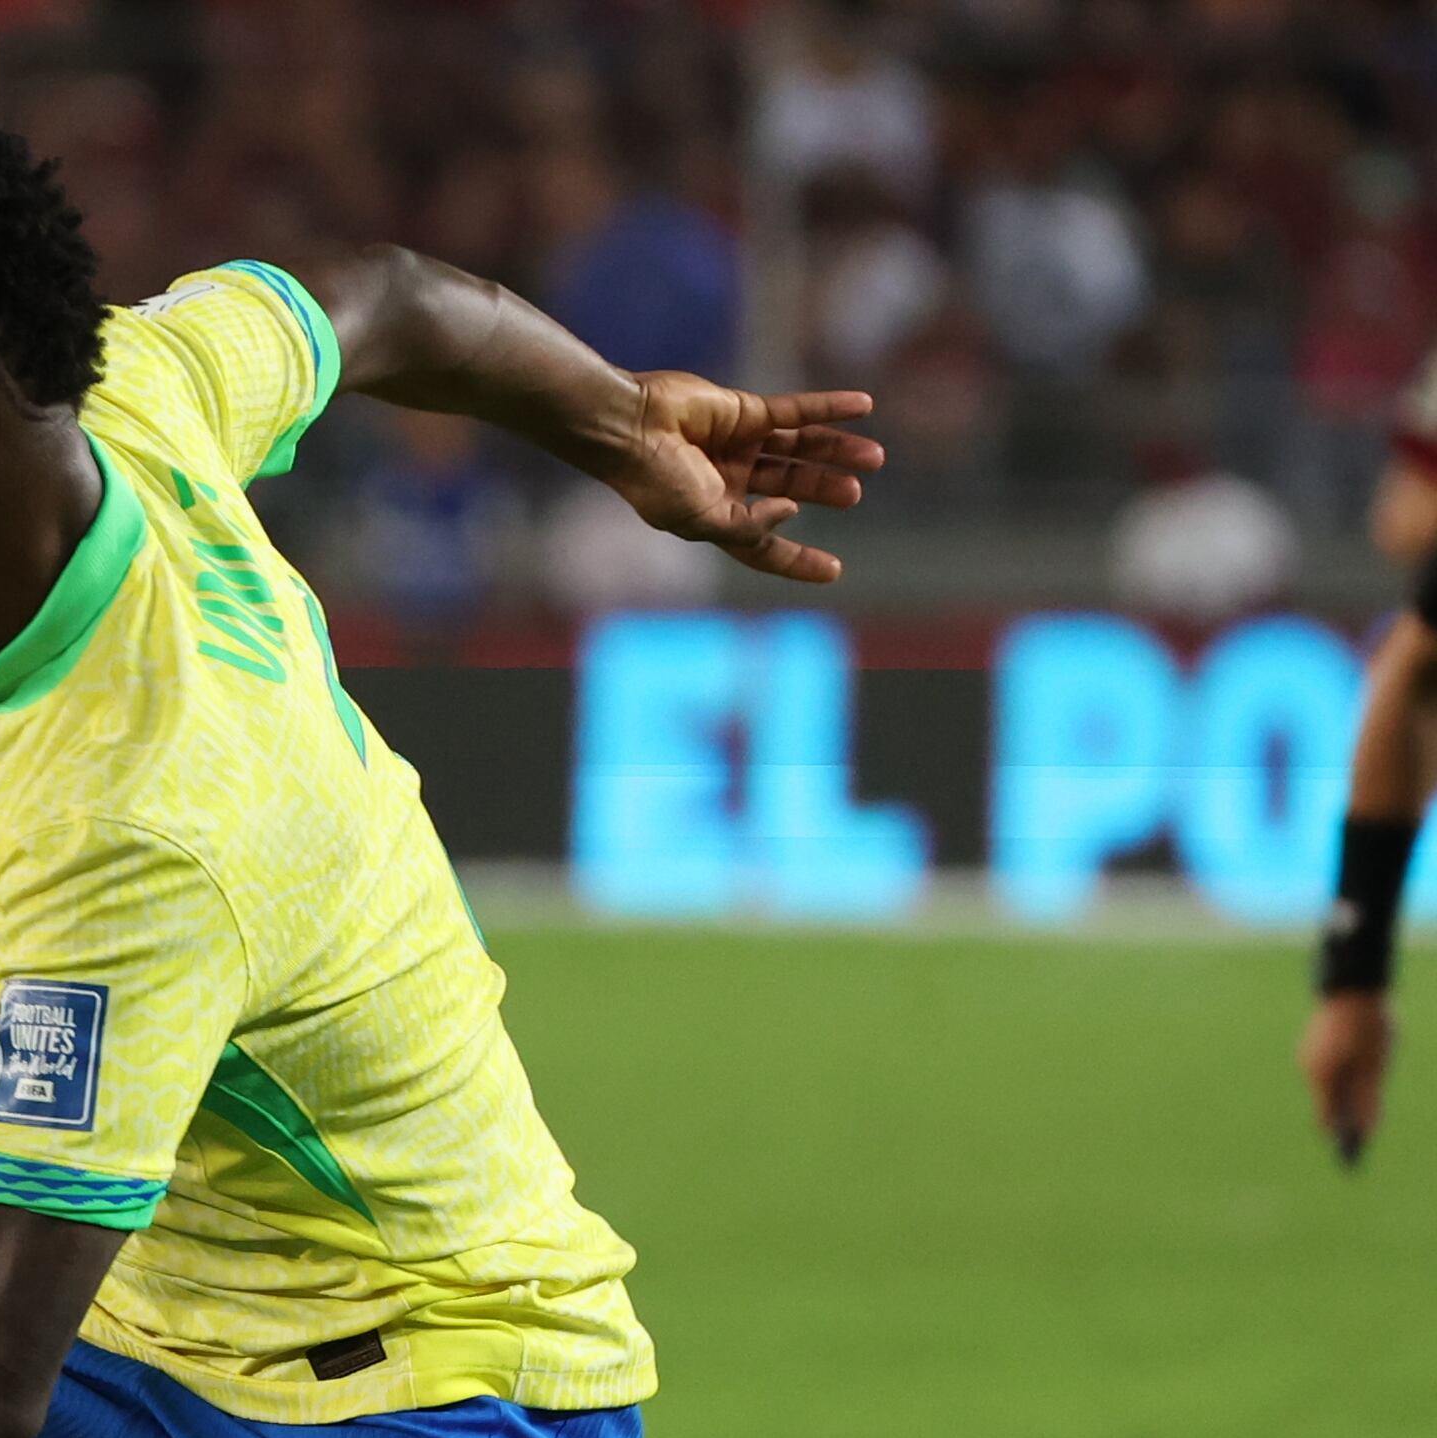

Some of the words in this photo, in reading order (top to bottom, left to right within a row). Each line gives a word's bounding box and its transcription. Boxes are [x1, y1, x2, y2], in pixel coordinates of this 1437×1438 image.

[572, 612, 929, 918] EL
[989, 612, 1437, 924] PO
[10, 1002, 76, 1028] FOOTBALL
[9, 1022, 75, 1055] UNITES
